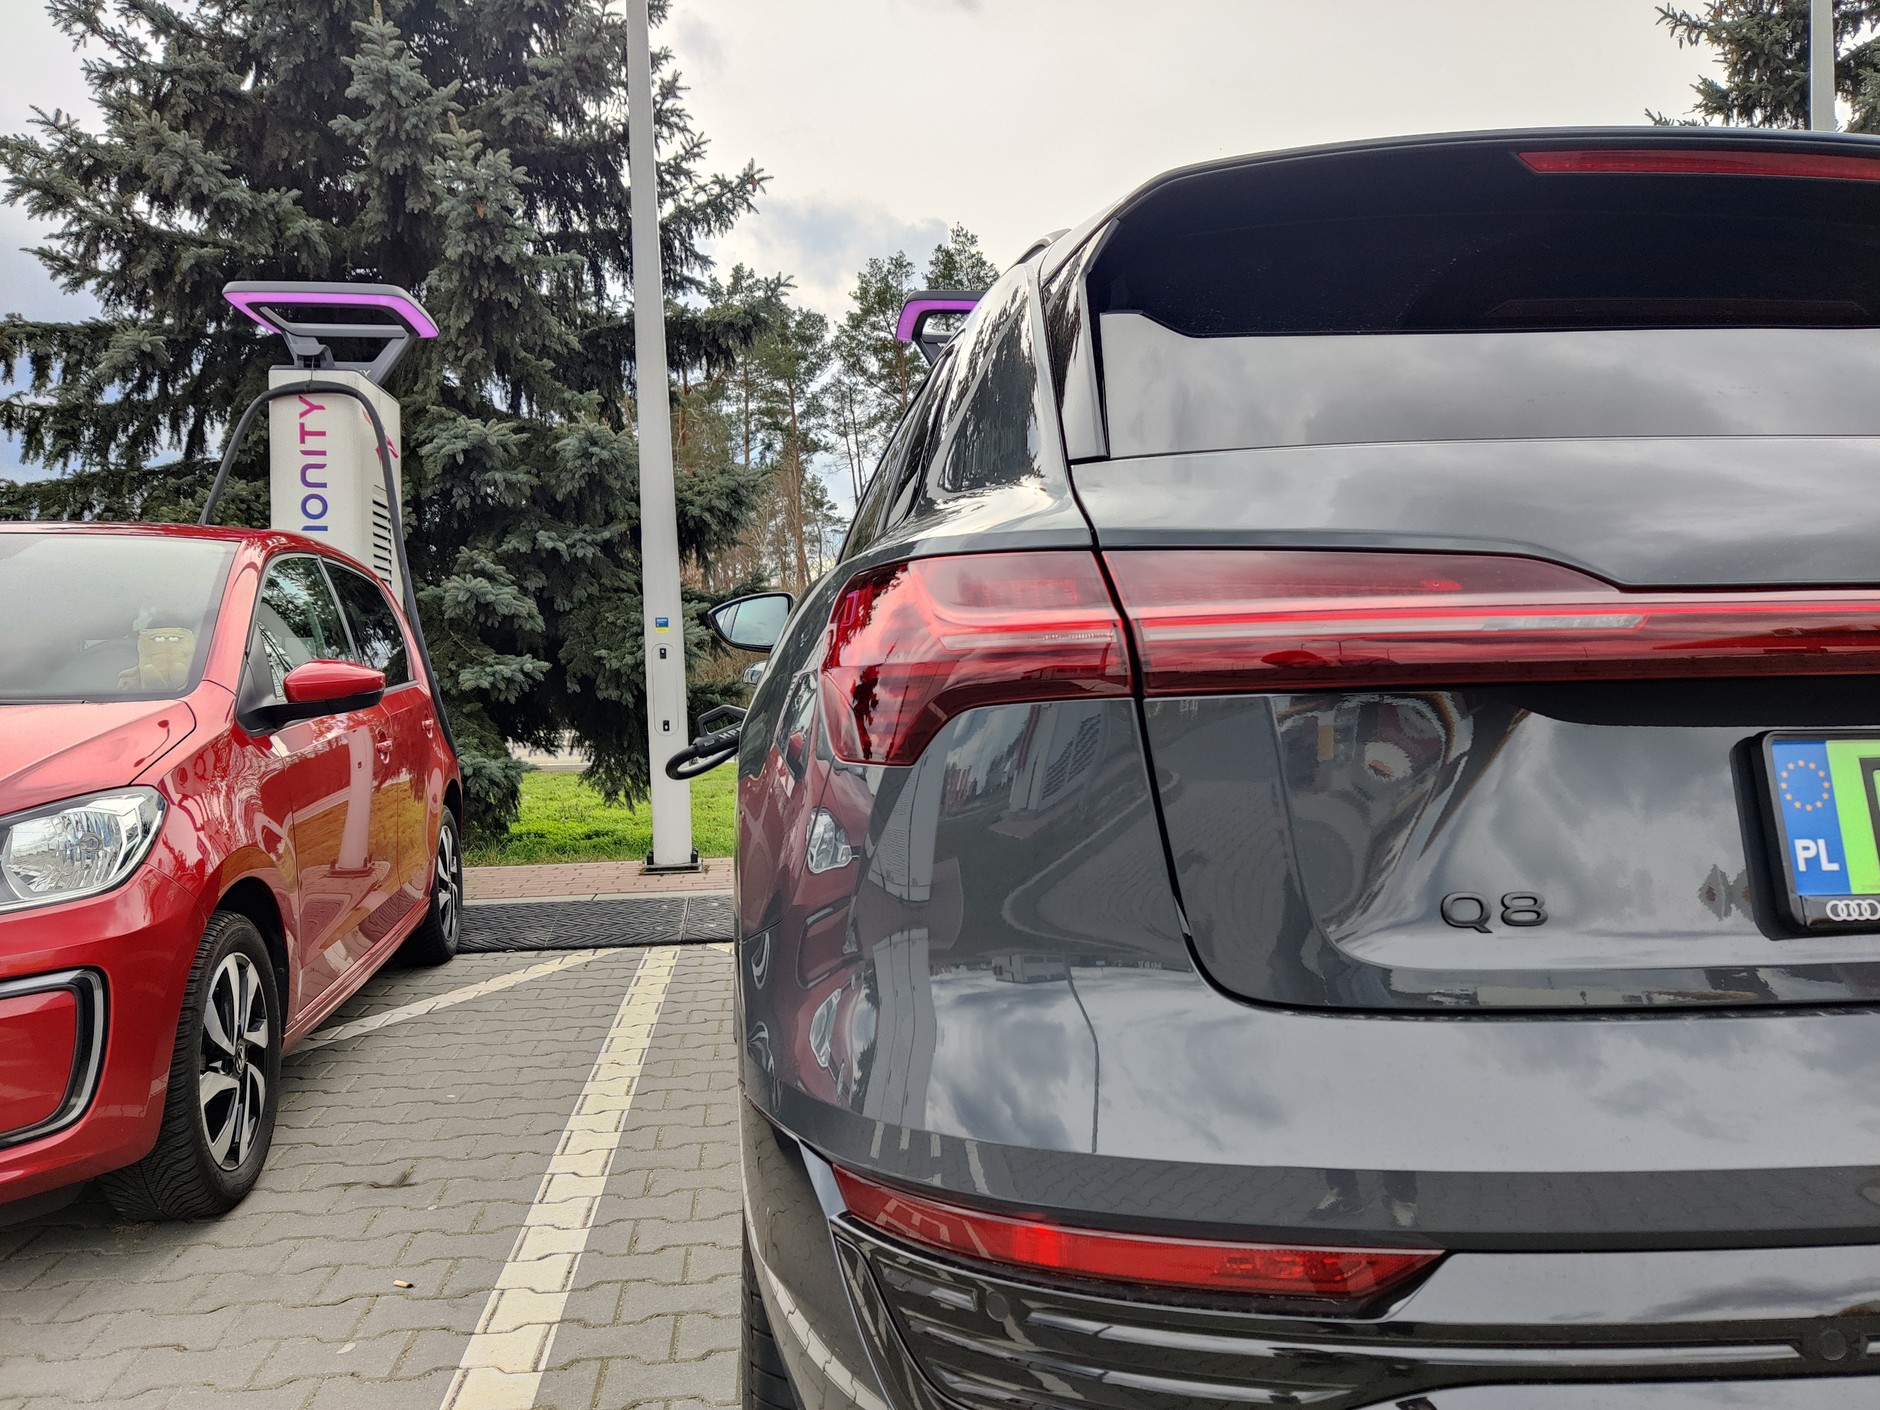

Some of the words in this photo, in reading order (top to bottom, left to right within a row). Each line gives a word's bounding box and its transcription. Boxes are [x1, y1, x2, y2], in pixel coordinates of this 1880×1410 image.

[298, 394, 329, 532] IONITY
[1794, 838, 1841, 872] PL
[1440, 891, 1549, 934] Q8
